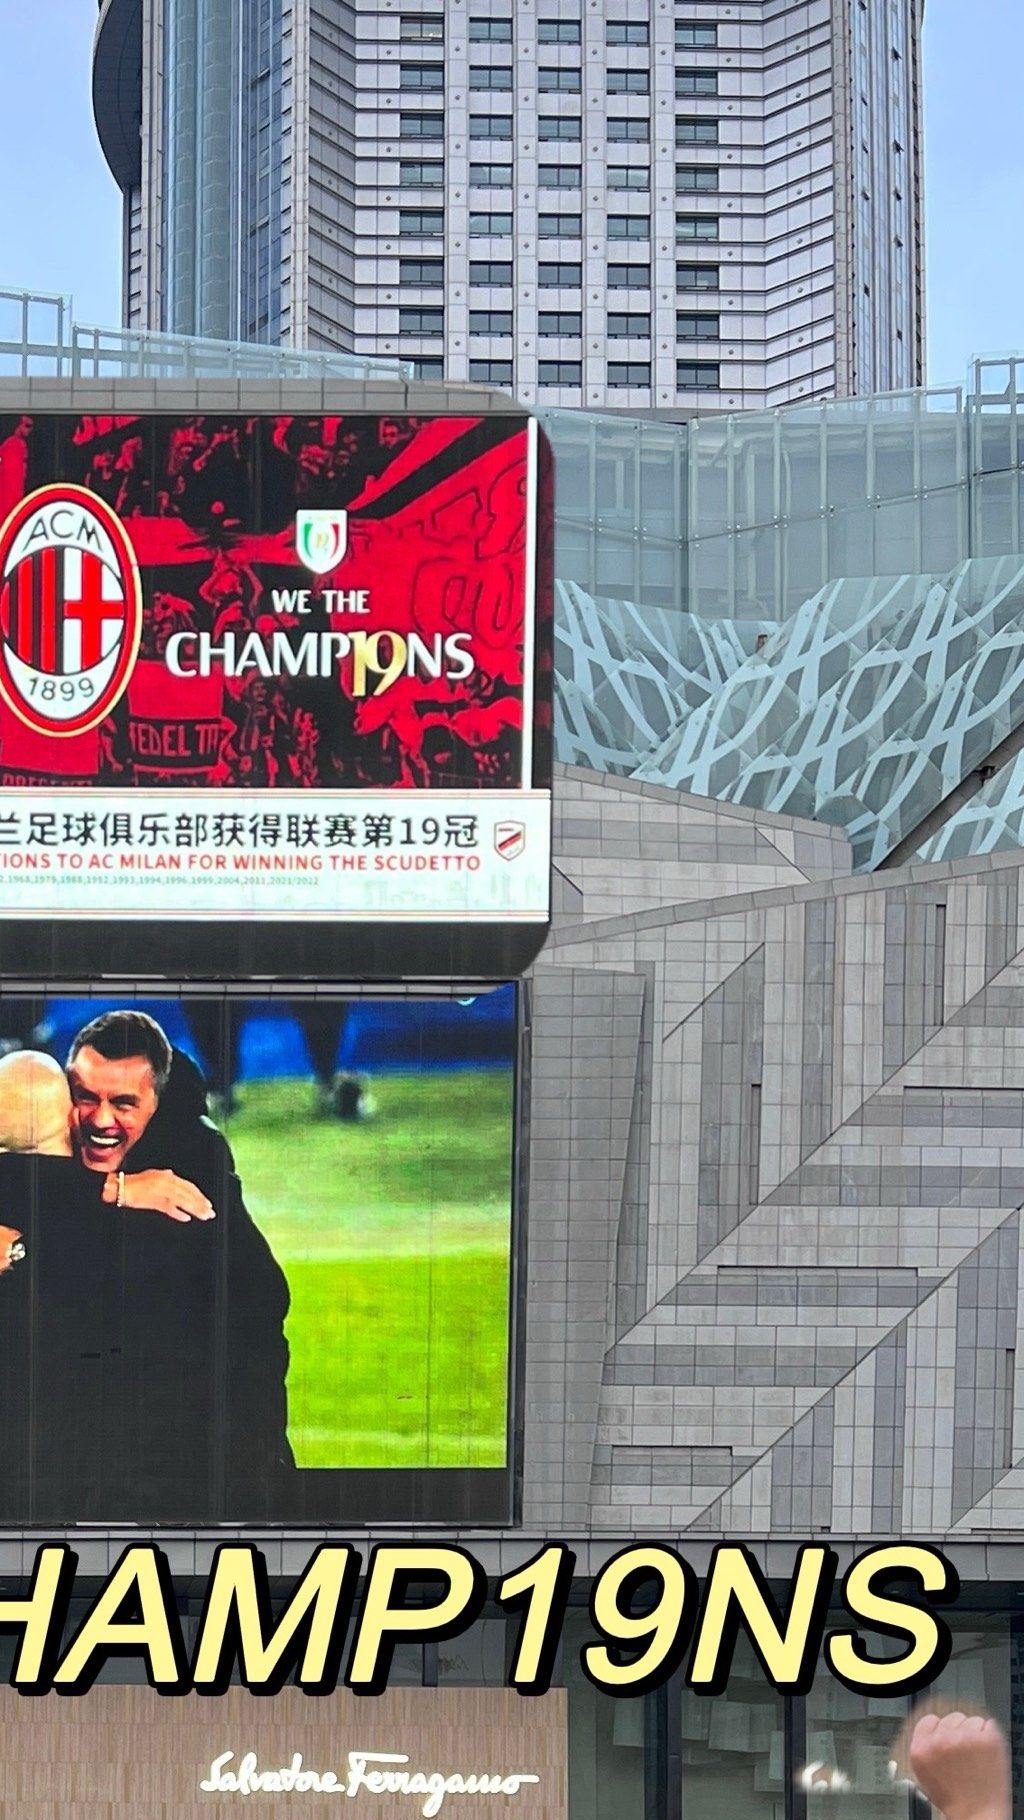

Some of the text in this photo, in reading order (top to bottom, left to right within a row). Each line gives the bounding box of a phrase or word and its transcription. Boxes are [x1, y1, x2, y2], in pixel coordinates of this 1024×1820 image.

[21, 509, 103, 553] ACM
[271, 589, 370, 614] WE THE
[165, 629, 475, 697] CHAMP19NS
[28, 676, 96, 702] 1899
[57, 853, 83, 870] TO
[88, 853, 114, 870] AC
[120, 853, 182, 870] MILAN
[188, 854, 228, 870] FOR
[233, 854, 323, 871] WINNING
[329, 855, 367, 871] THE
[374, 855, 481, 871] SCUDETTO
[200, 1750, 540, 1818] Salvatore Ferragamo
